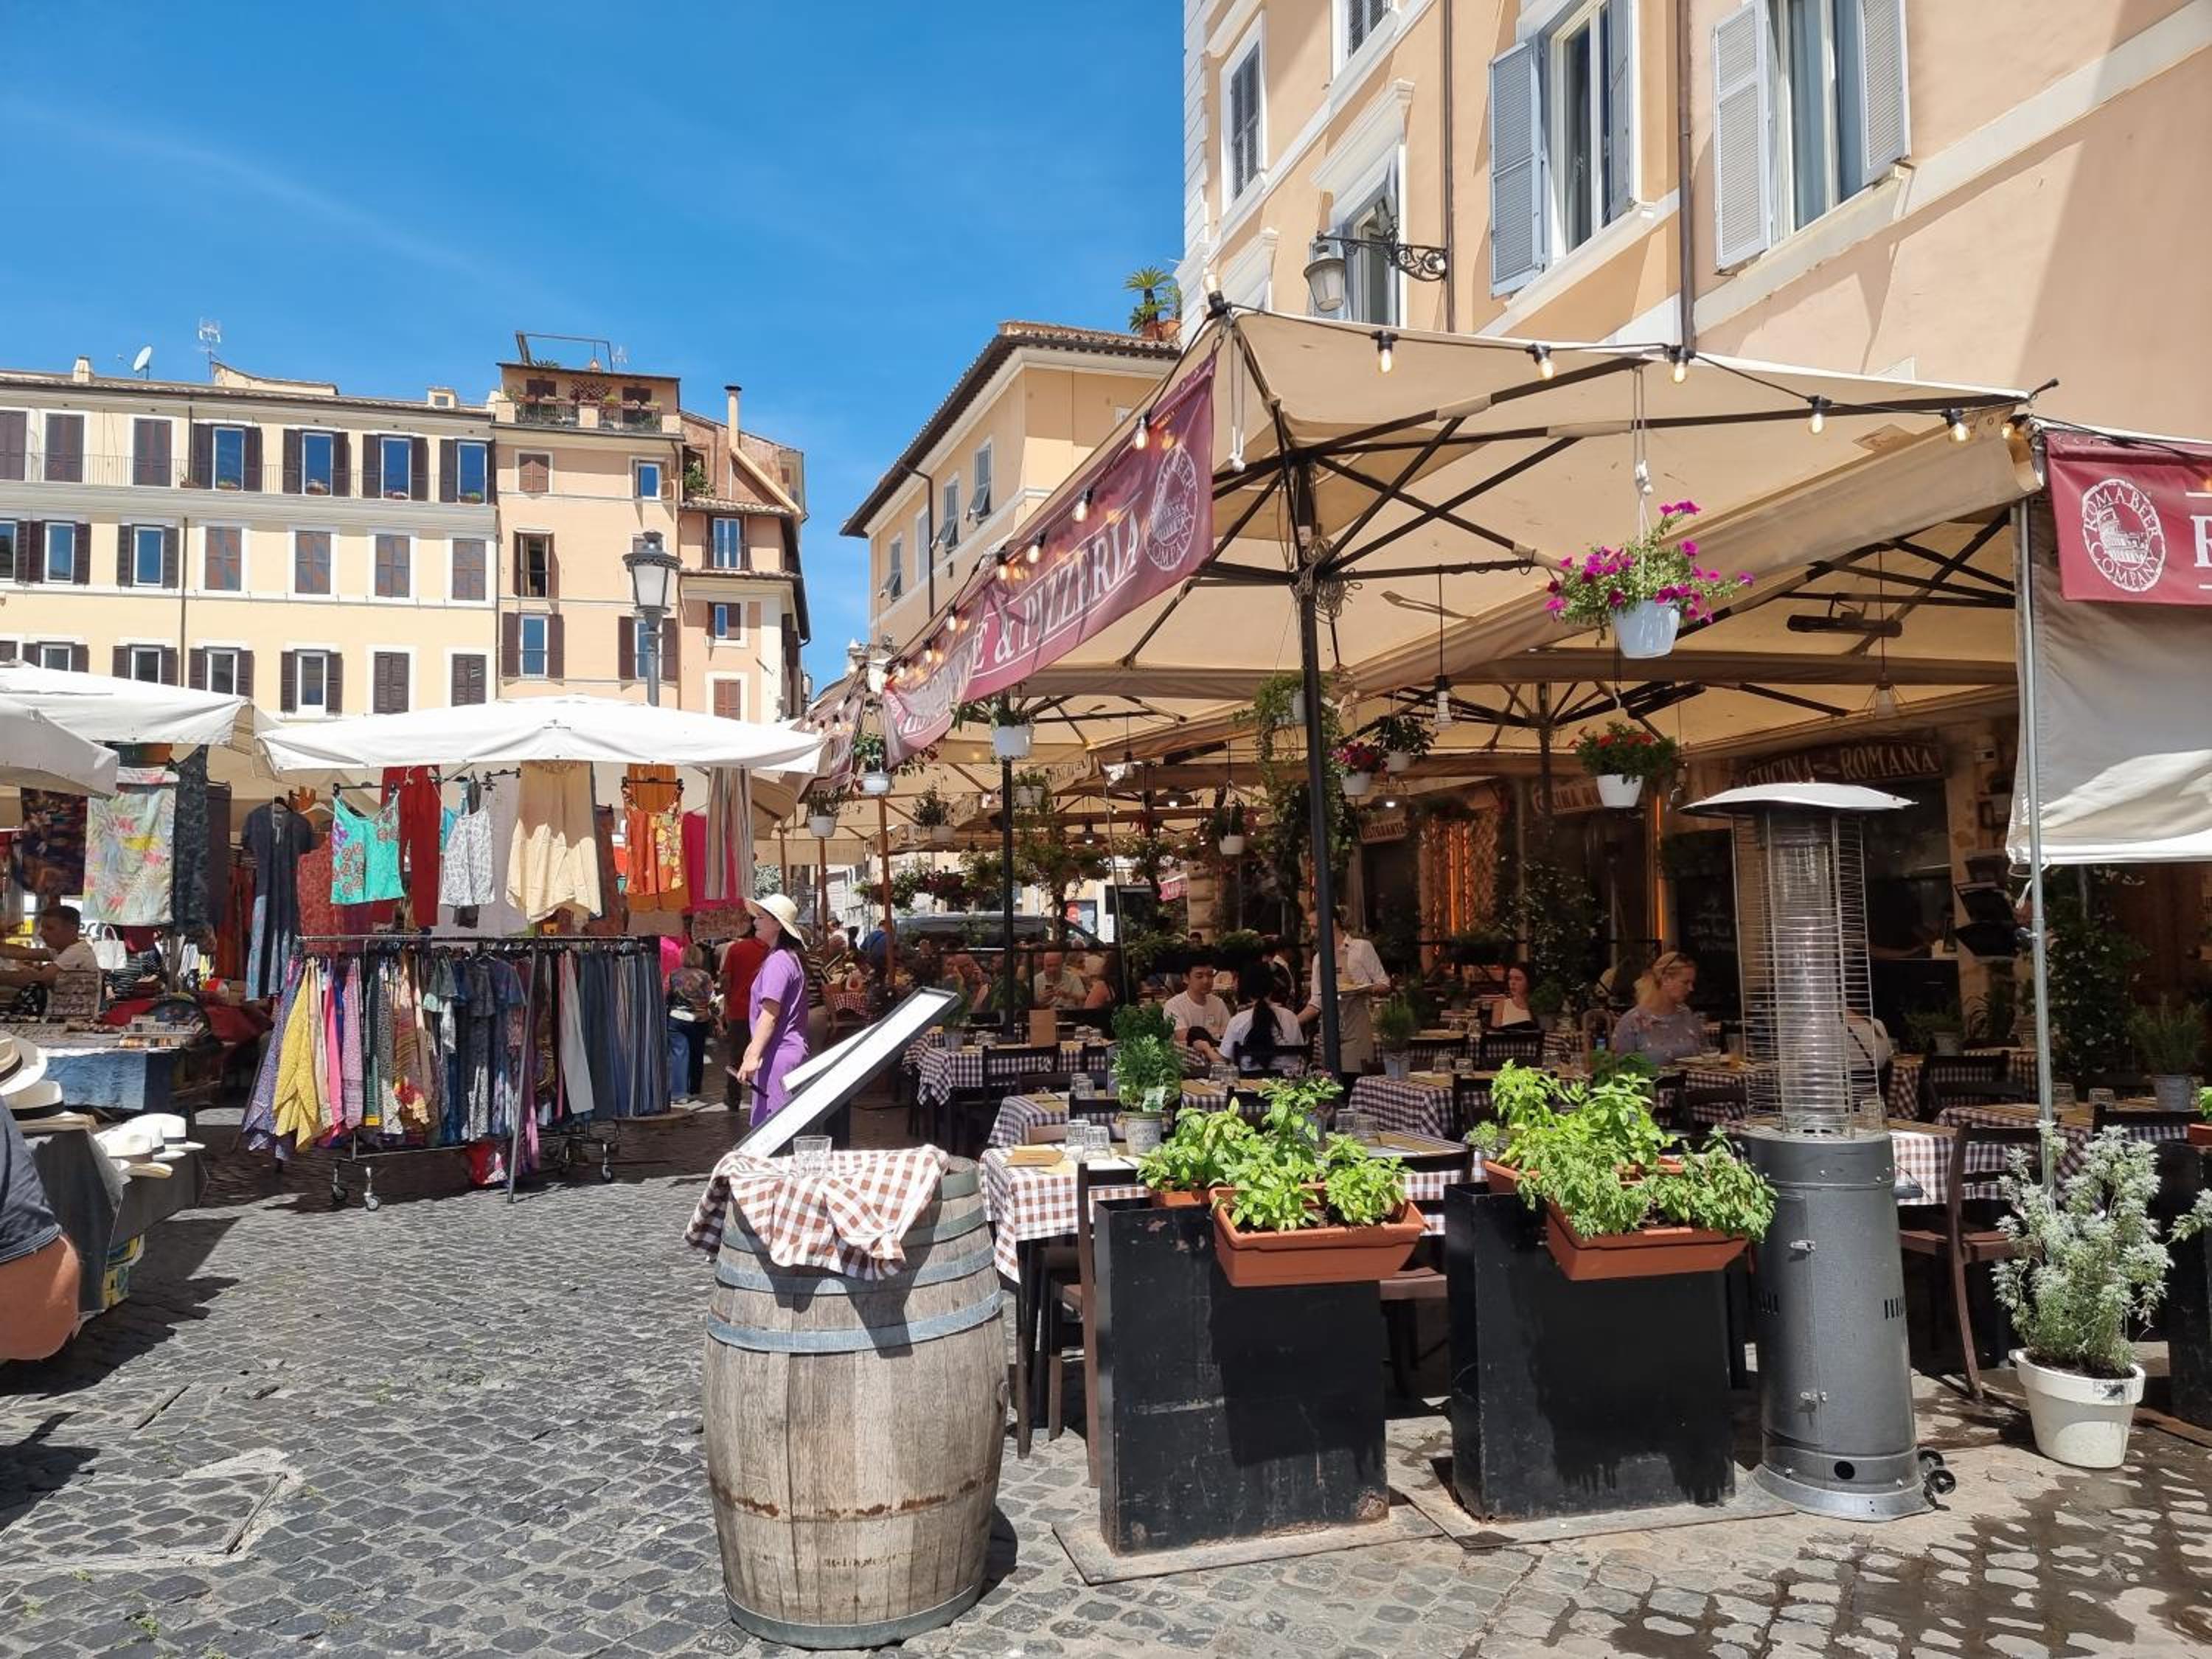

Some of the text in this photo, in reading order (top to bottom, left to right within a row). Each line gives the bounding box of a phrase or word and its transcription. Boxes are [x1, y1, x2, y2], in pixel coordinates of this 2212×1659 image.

[2084, 487, 2159, 535] ROMA BEER
[995, 509, 1140, 664] & PIZZERIA
[2090, 541, 2160, 586] COMPANY
[1745, 745, 1940, 786] CUCINA ROMANA
